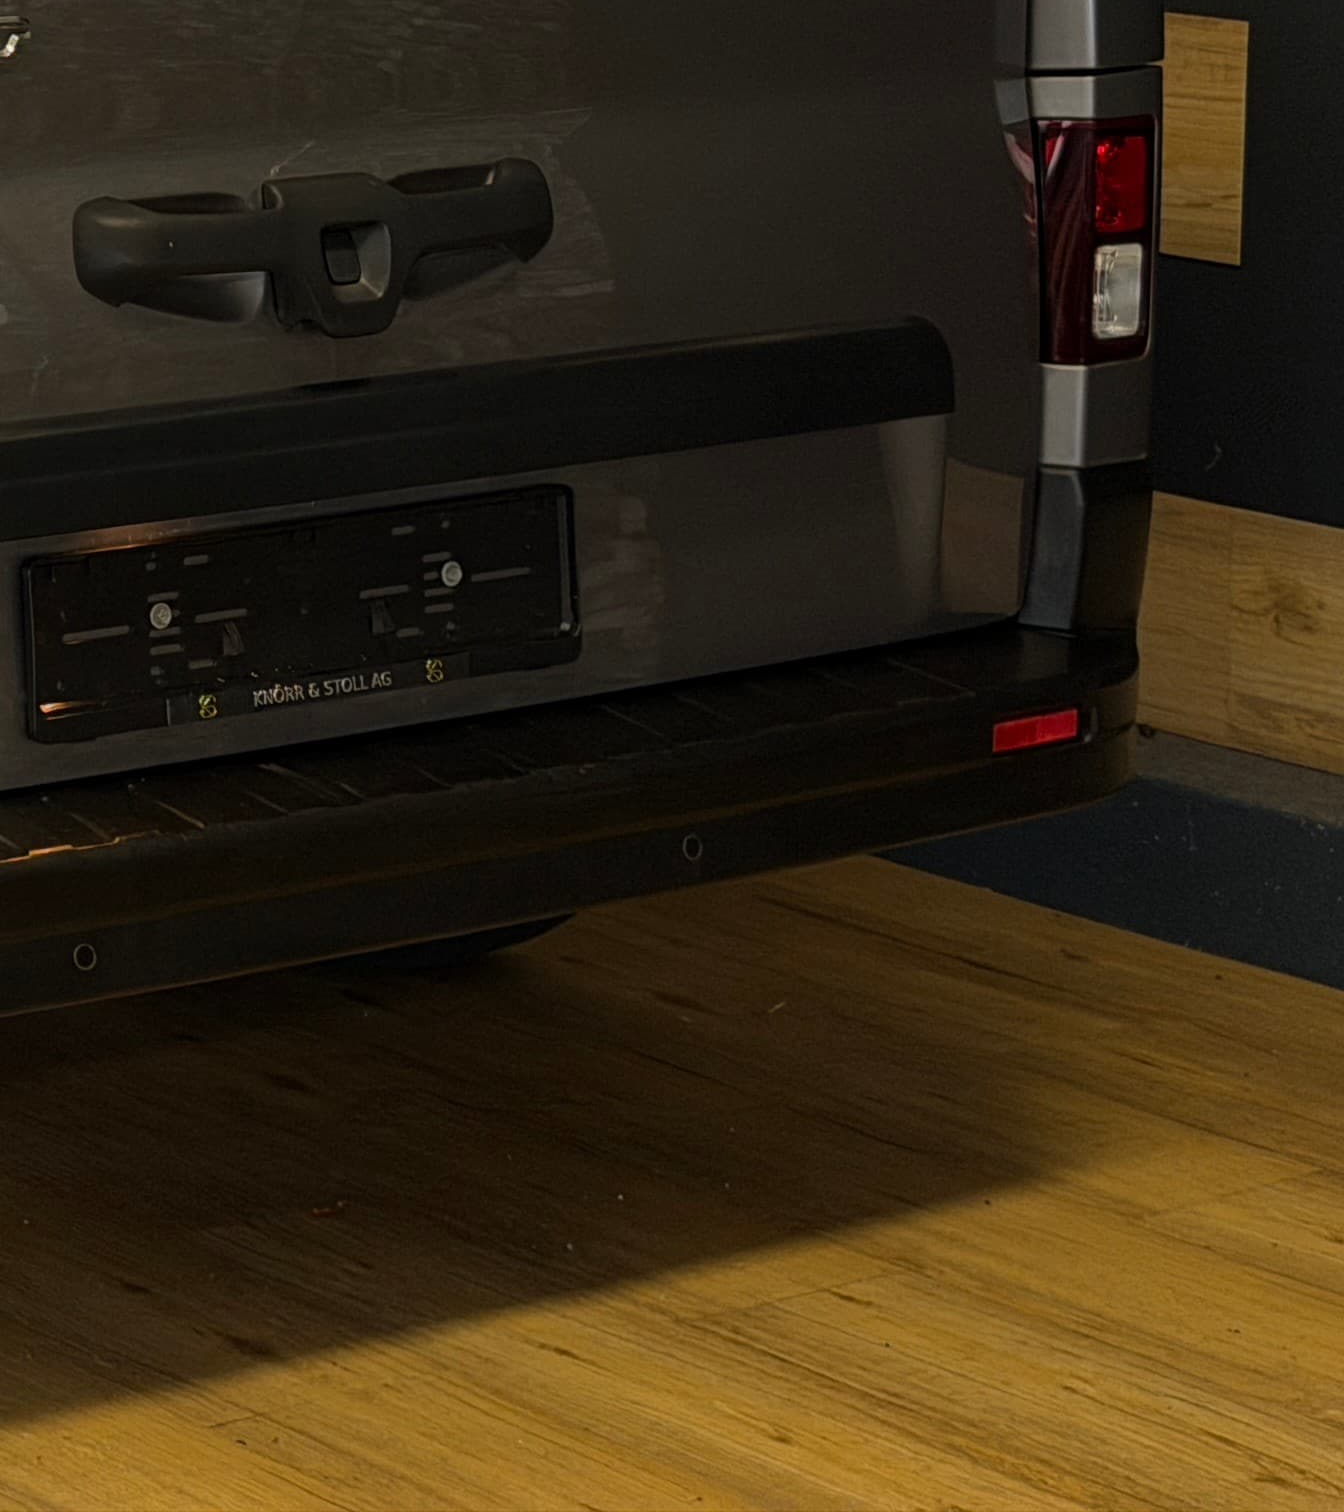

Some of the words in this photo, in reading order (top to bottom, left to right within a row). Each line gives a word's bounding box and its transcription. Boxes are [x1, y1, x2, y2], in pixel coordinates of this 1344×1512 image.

[308, 682, 321, 699] &
[323, 674, 369, 696] STOLL
[371, 671, 393, 689] AG
